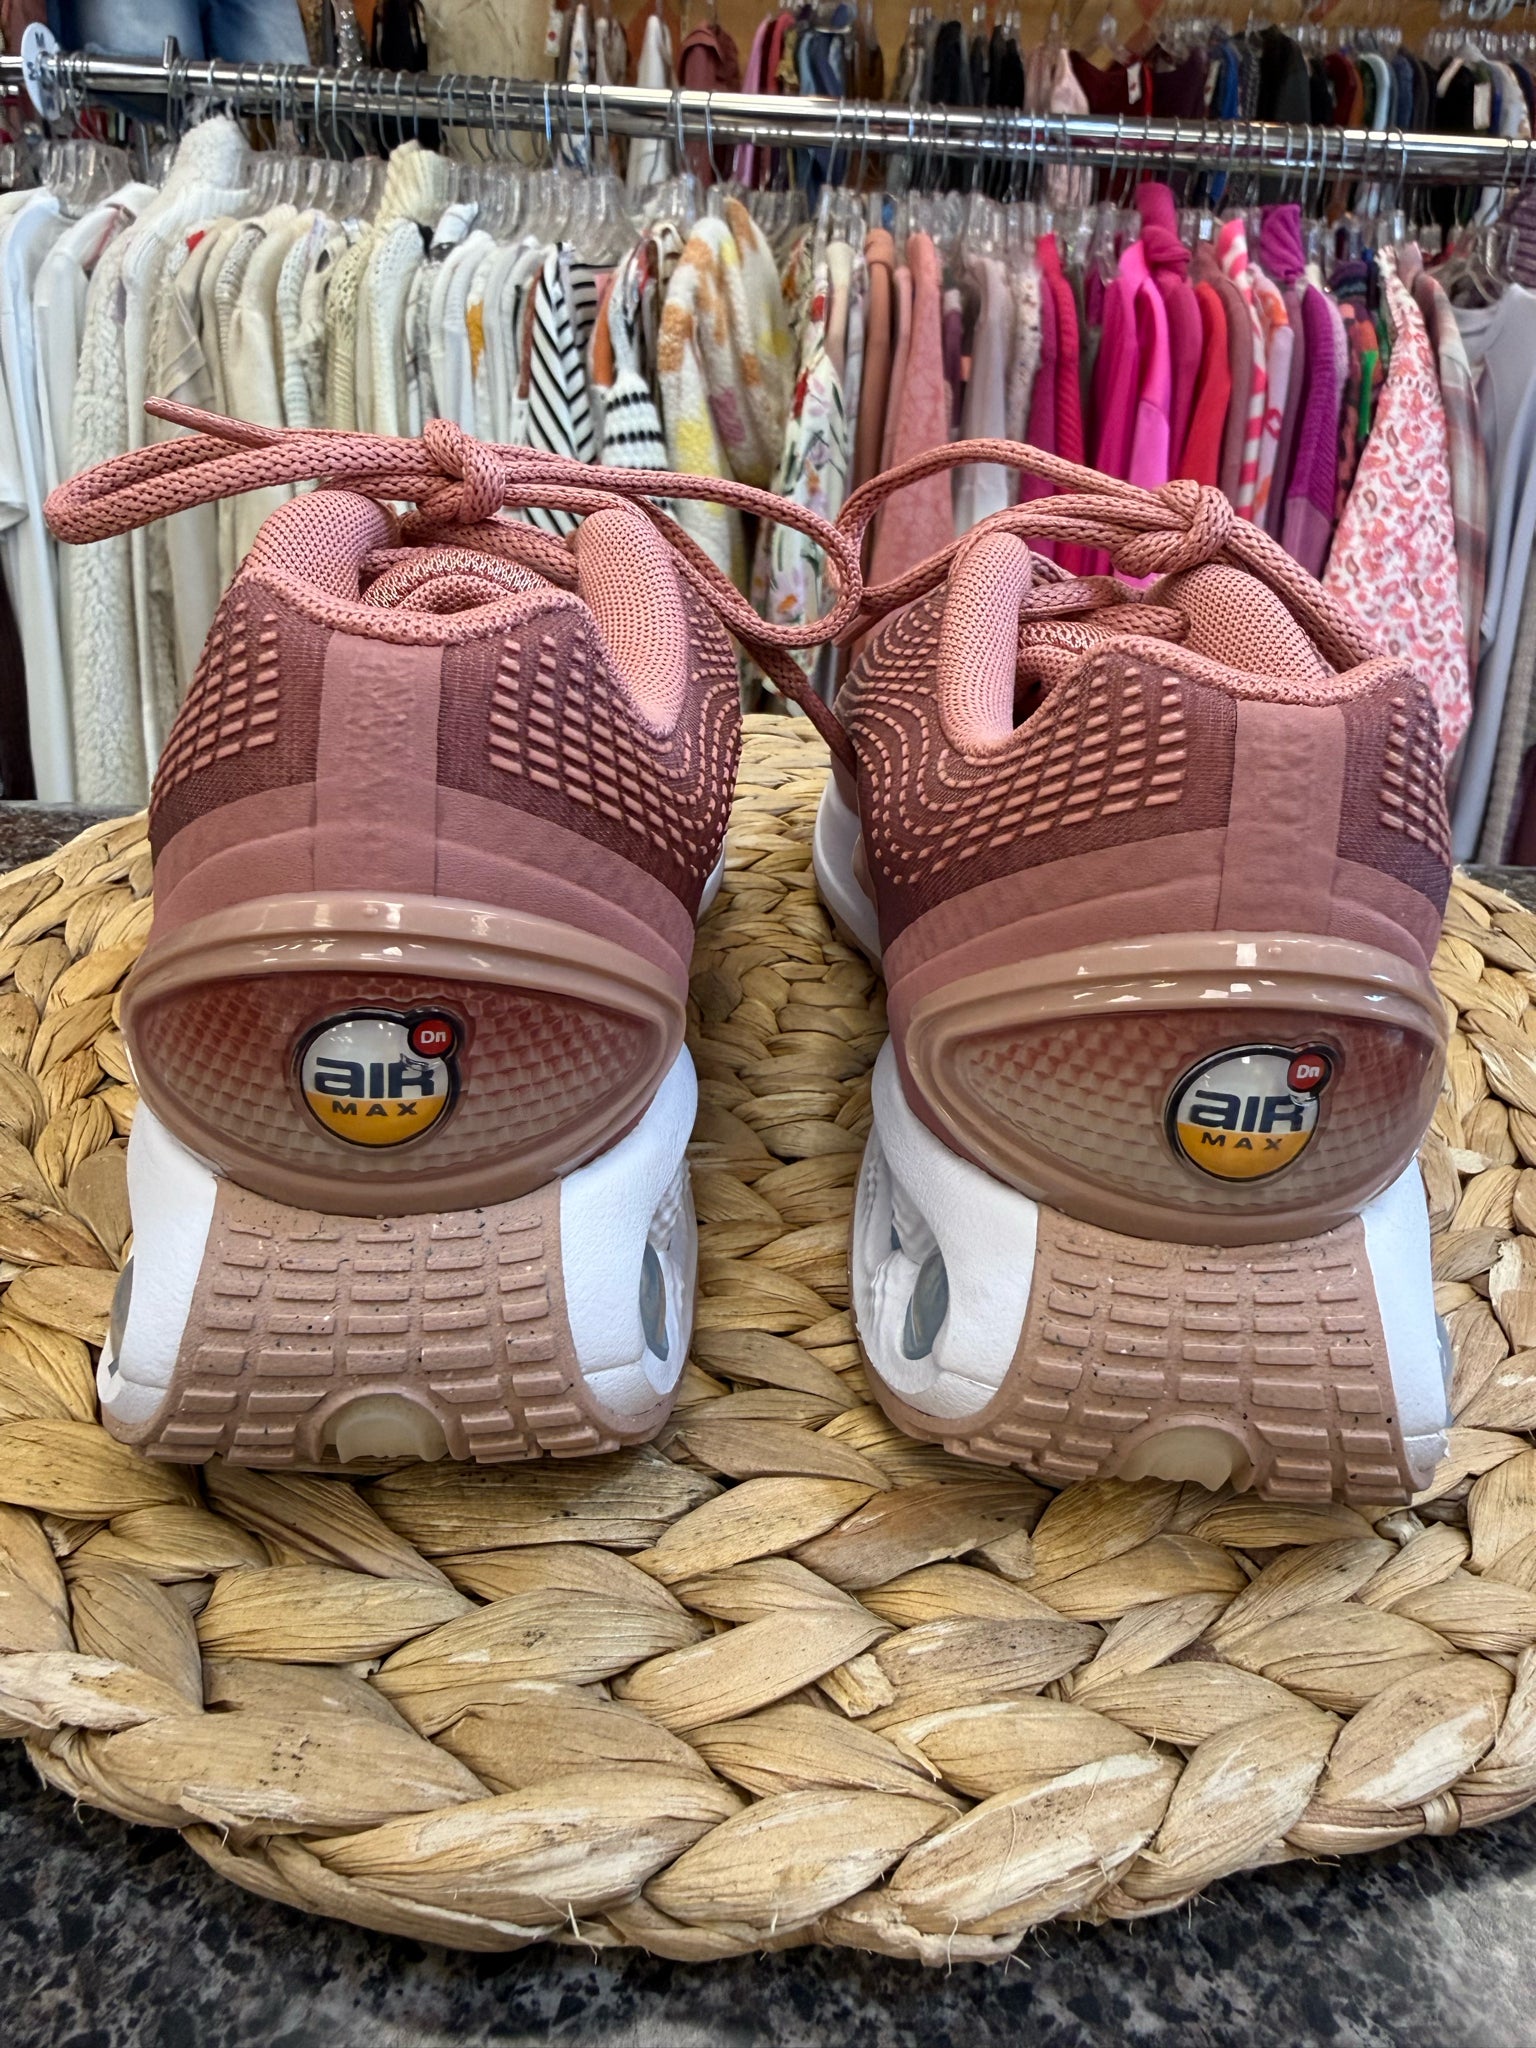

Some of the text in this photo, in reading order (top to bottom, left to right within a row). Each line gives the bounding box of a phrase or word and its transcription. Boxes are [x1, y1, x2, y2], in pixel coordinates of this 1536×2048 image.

[420, 1030, 446, 1044] Dn
[1296, 1064, 1320, 1079] Dn
[332, 1101, 417, 1116] MAX
[1201, 1132, 1283, 1150] MAX
